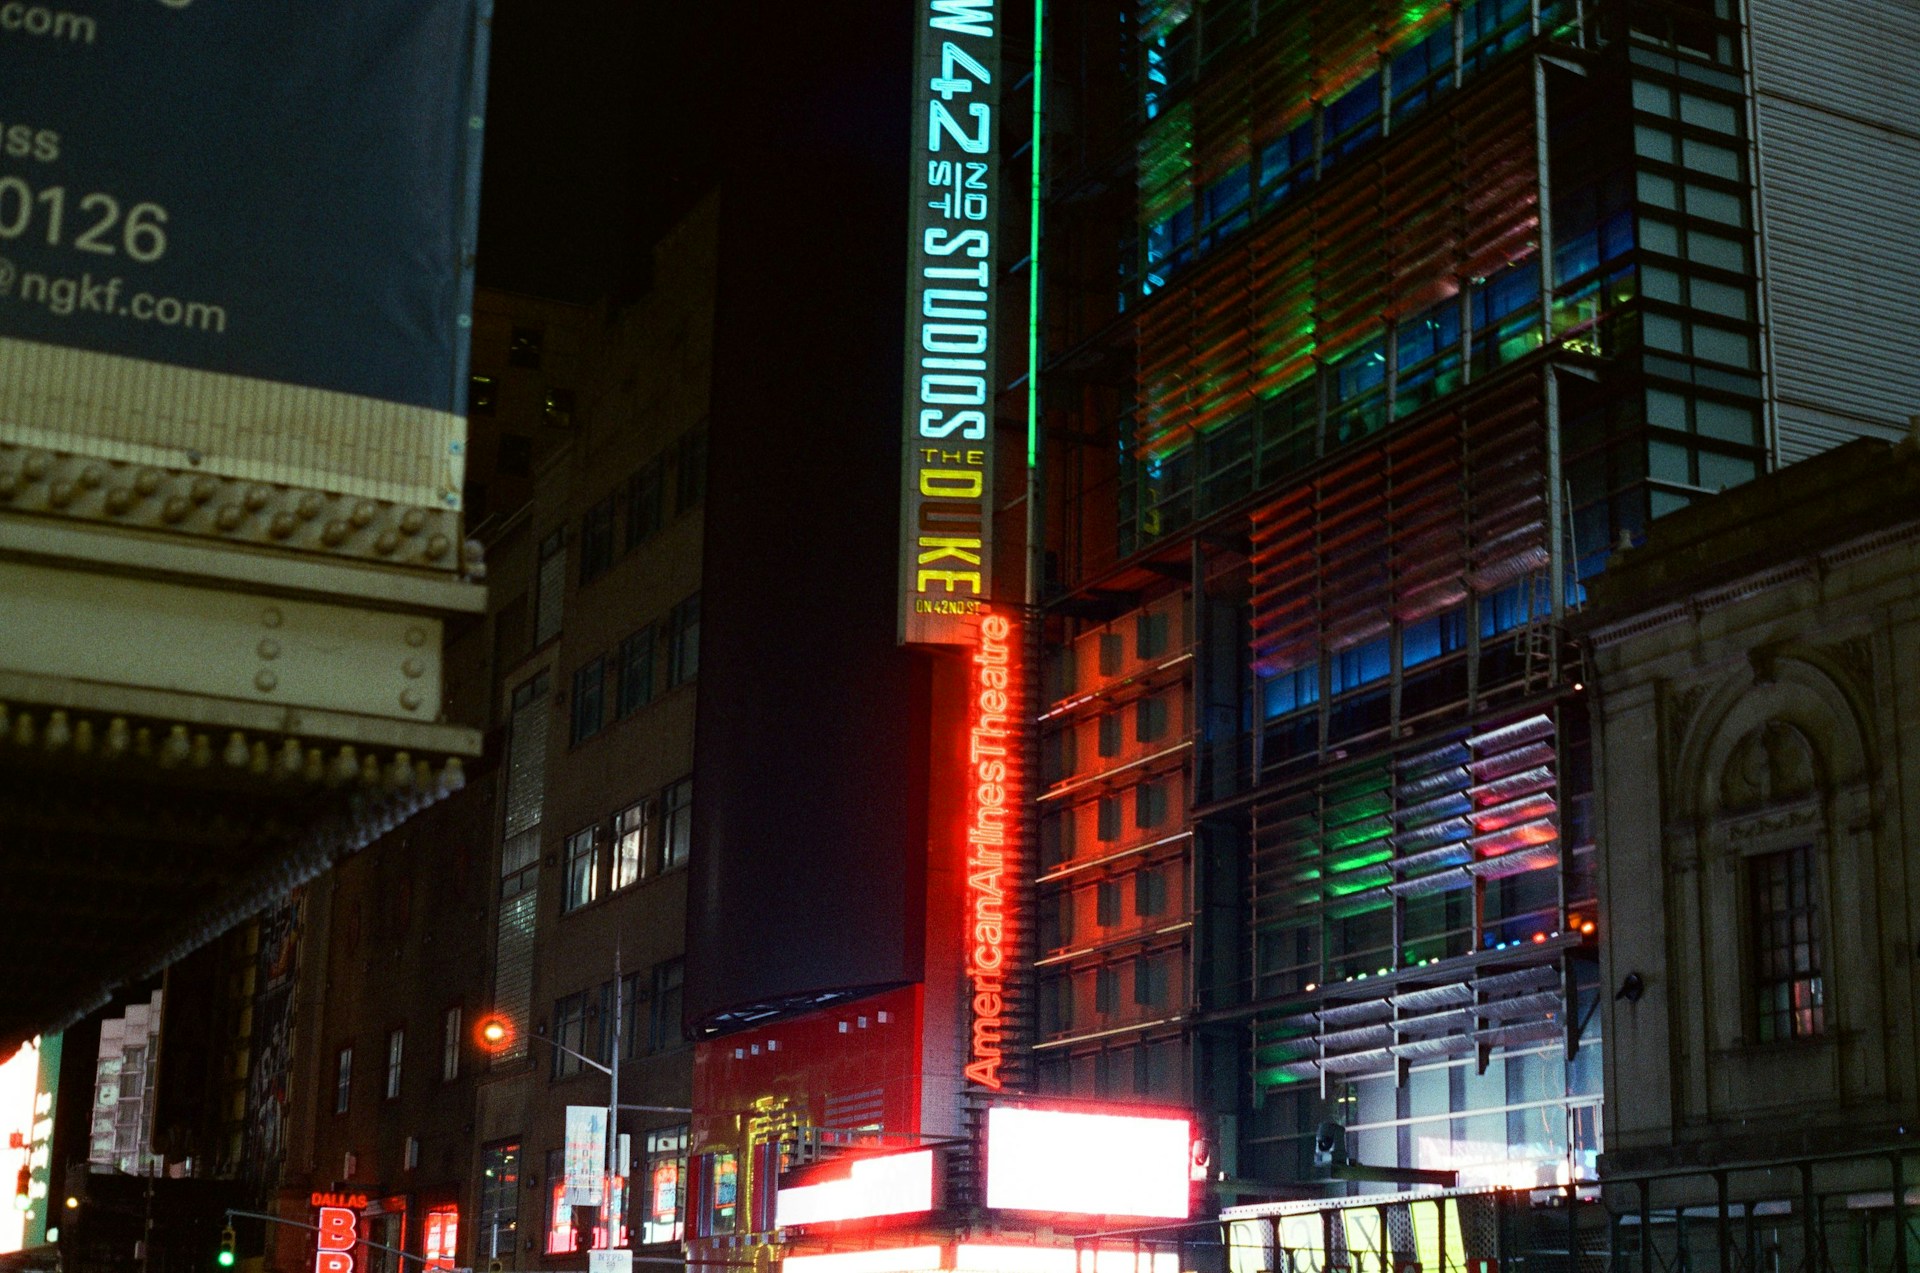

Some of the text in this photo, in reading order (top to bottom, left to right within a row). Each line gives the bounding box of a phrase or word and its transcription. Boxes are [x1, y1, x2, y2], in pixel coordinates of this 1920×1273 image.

[0, 122, 60, 162] ss
[920, 227, 989, 439] STUDIOS
[919, 448, 985, 465] THE
[917, 468, 983, 594] DUKE
[916, 599, 982, 616] ON 42ND ST
[311, 1192, 368, 1209] DALLAS
